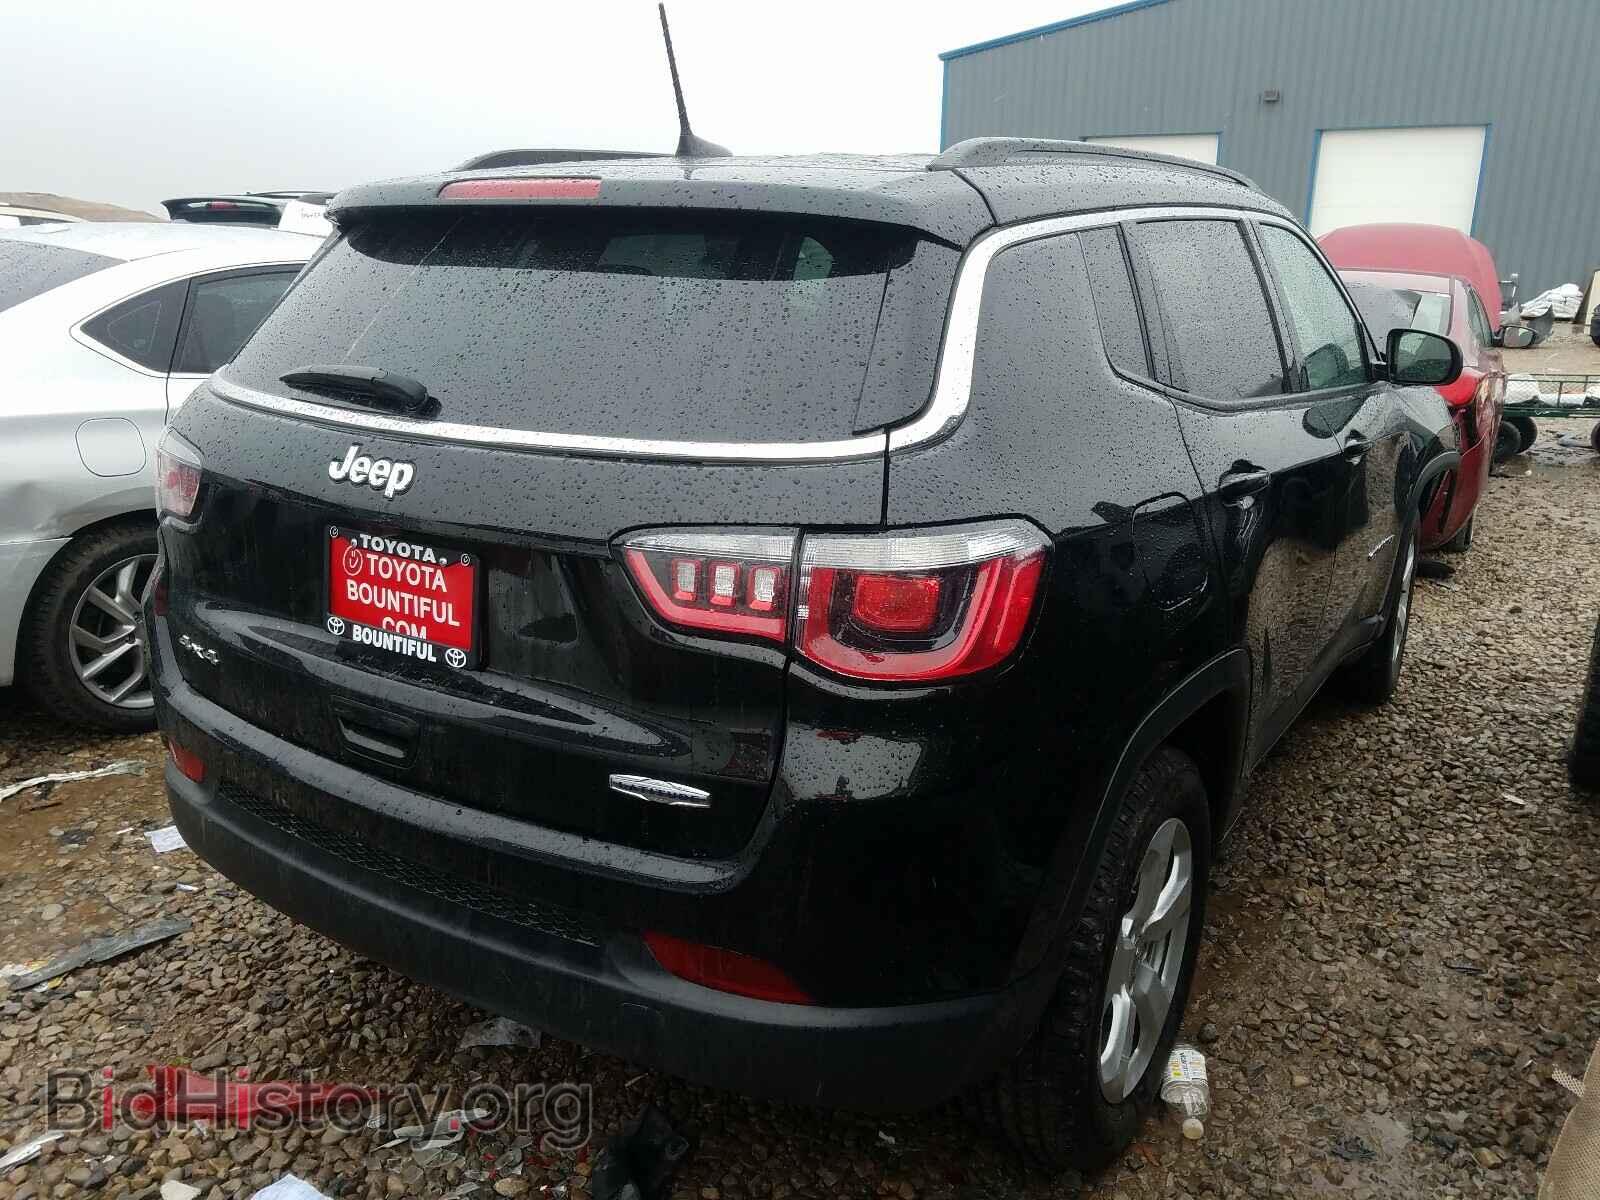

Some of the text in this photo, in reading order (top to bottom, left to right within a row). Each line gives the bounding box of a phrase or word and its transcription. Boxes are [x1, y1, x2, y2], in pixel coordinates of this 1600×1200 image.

[328, 444, 415, 499] Jeep
[359, 533, 437, 564] TOYOTA
[366, 553, 448, 593] TOYOTA
[346, 579, 461, 627] BOUNTIFUL
[352, 624, 437, 662] BOUNTIFUL
